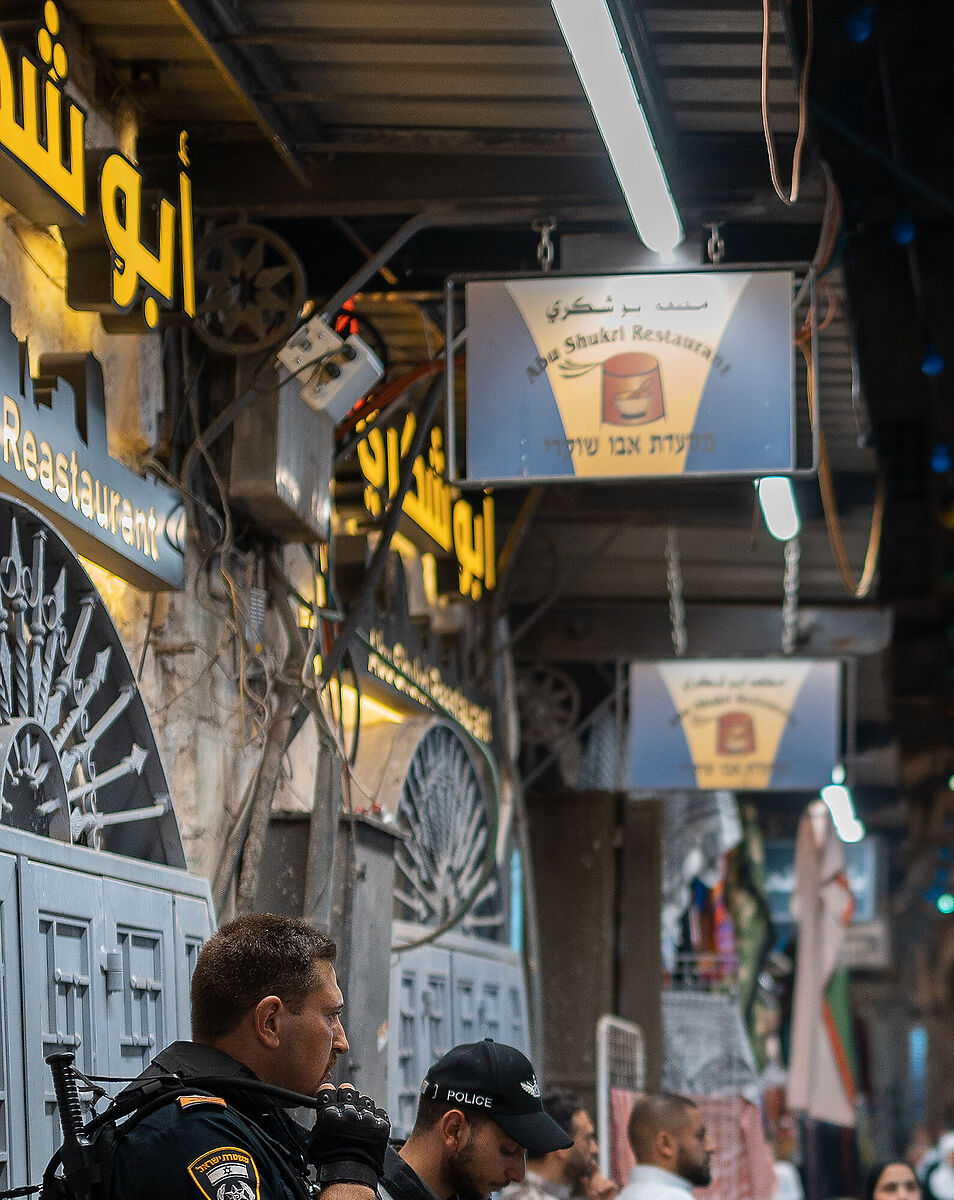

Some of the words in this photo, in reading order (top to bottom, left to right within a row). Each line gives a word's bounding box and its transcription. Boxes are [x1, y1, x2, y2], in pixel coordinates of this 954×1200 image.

[546, 294, 614, 323] شكري
[525, 347, 560, 384] Abu
[564, 324, 626, 354] Shukri
[631, 324, 734, 378] Restaurant
[608, 434, 640, 456] אבו
[4, 394, 160, 562] Reastaurant
[447, 1089, 493, 1108] POLICE
[194, 1155, 222, 1174] ישראל
[221, 1153, 250, 1164] משטרת
